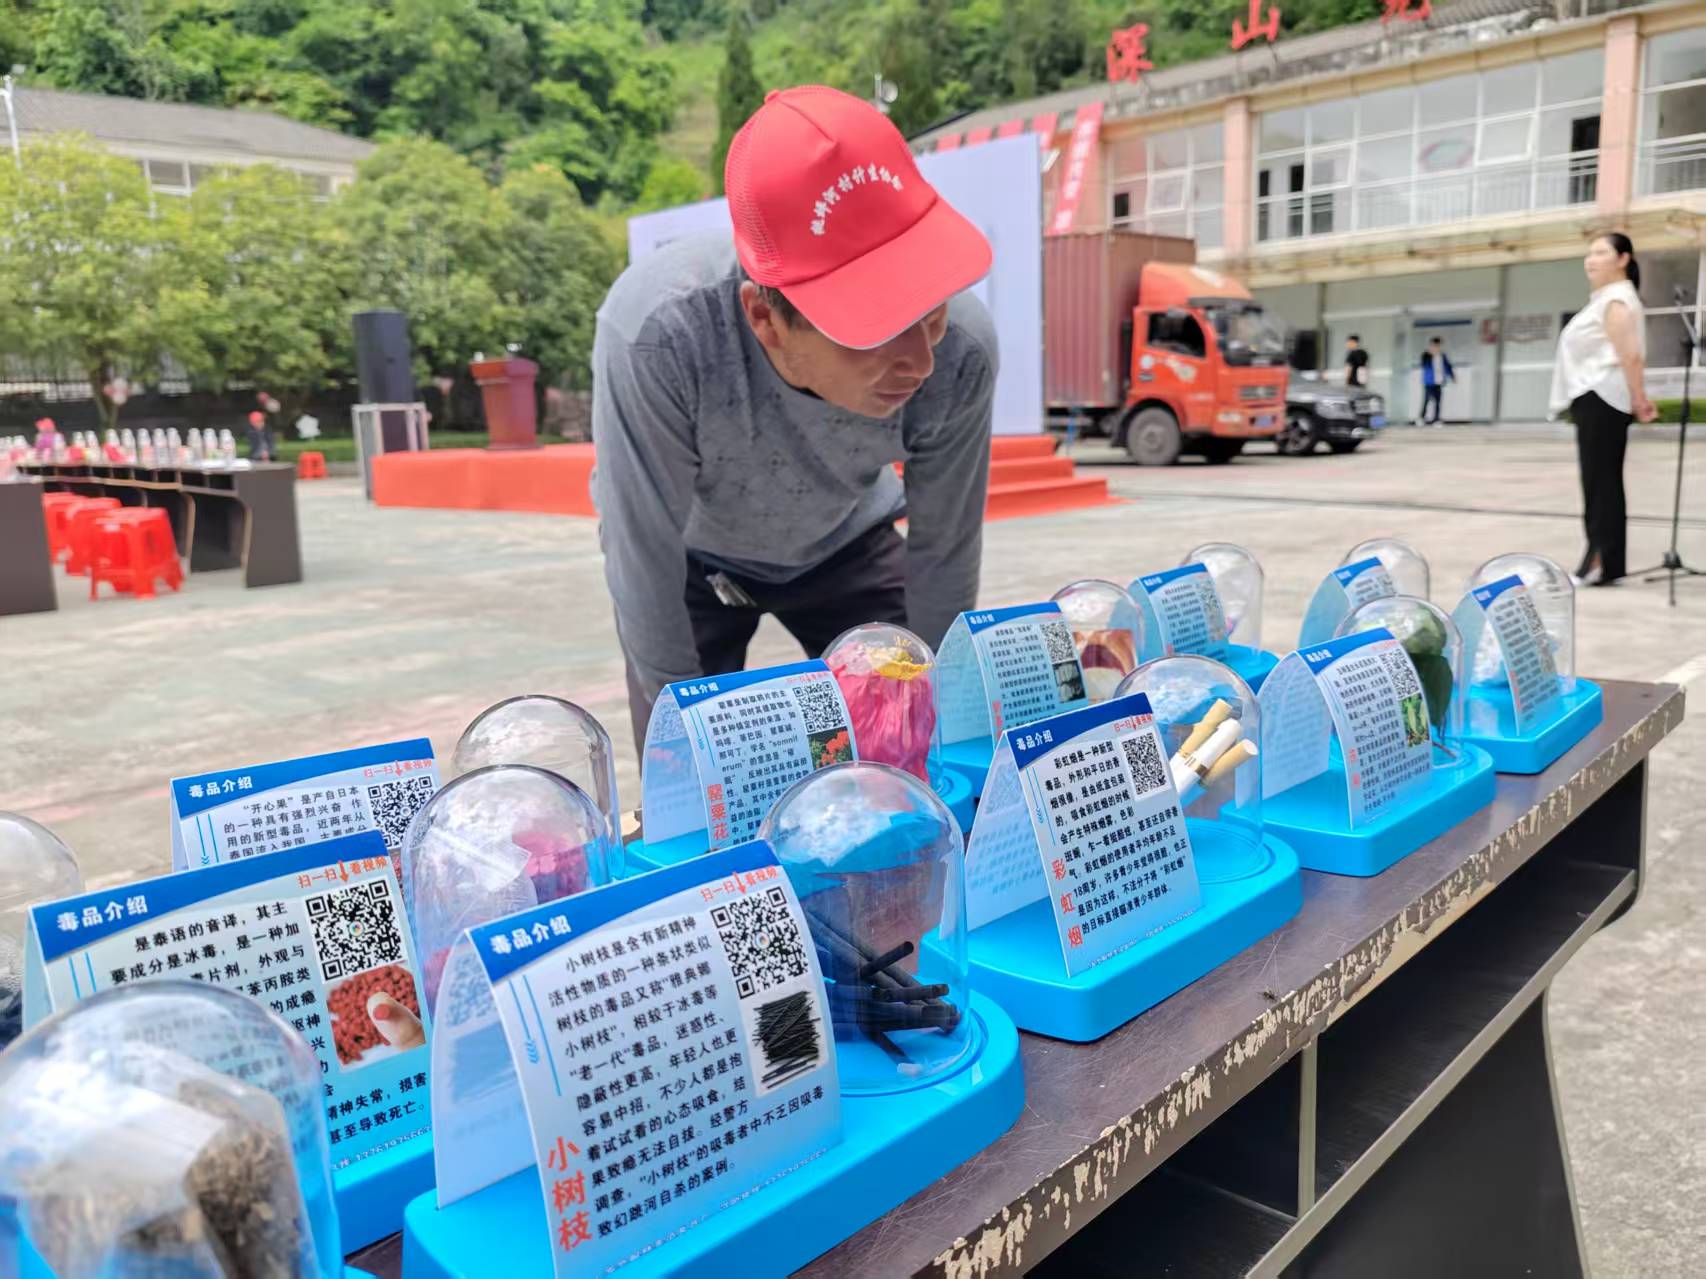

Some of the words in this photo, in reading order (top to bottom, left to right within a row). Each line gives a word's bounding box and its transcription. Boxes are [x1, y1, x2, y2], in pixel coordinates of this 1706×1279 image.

[1016, 730, 1054, 751] 毒品介绍
[1054, 741, 1114, 769] 彩虹烟是一种新型
[189, 776, 253, 797] 毒品介绍
[1045, 760, 1121, 791] 毒品，外形和平日的香
[1050, 775, 1125, 809] 烟很像，是由纸盒包装
[1055, 790, 1131, 827] 的，吸食彩虹烟的时候
[58, 897, 147, 932] 毒品介绍
[134, 900, 287, 952] 是泰语的音译，其主
[1052, 859, 1083, 947] 彩虹烟
[110, 920, 300, 985] 要成分是冰毒，是一种加
[492, 915, 571, 955] 毒品介绍
[564, 913, 697, 974] 小树枝是含有新精神
[237, 966, 310, 998] 苯丙胺类
[547, 933, 712, 1008] 活性物质的一种条状类似
[574, 1026, 738, 1113] 隐蔽性更高，年轻人也更
[580, 1049, 743, 1138] 容易中招，不少人都是抱
[329, 1100, 425, 1144] 甚至导致死亡。
[585, 1074, 747, 1163] 着试试看的心态吸食，结
[588, 1098, 751, 1189] 果致瘾无法自拔。经警方
[547, 1135, 592, 1252] 小树枝
[596, 1152, 737, 1239] 致幻跳河自杀的案例。
